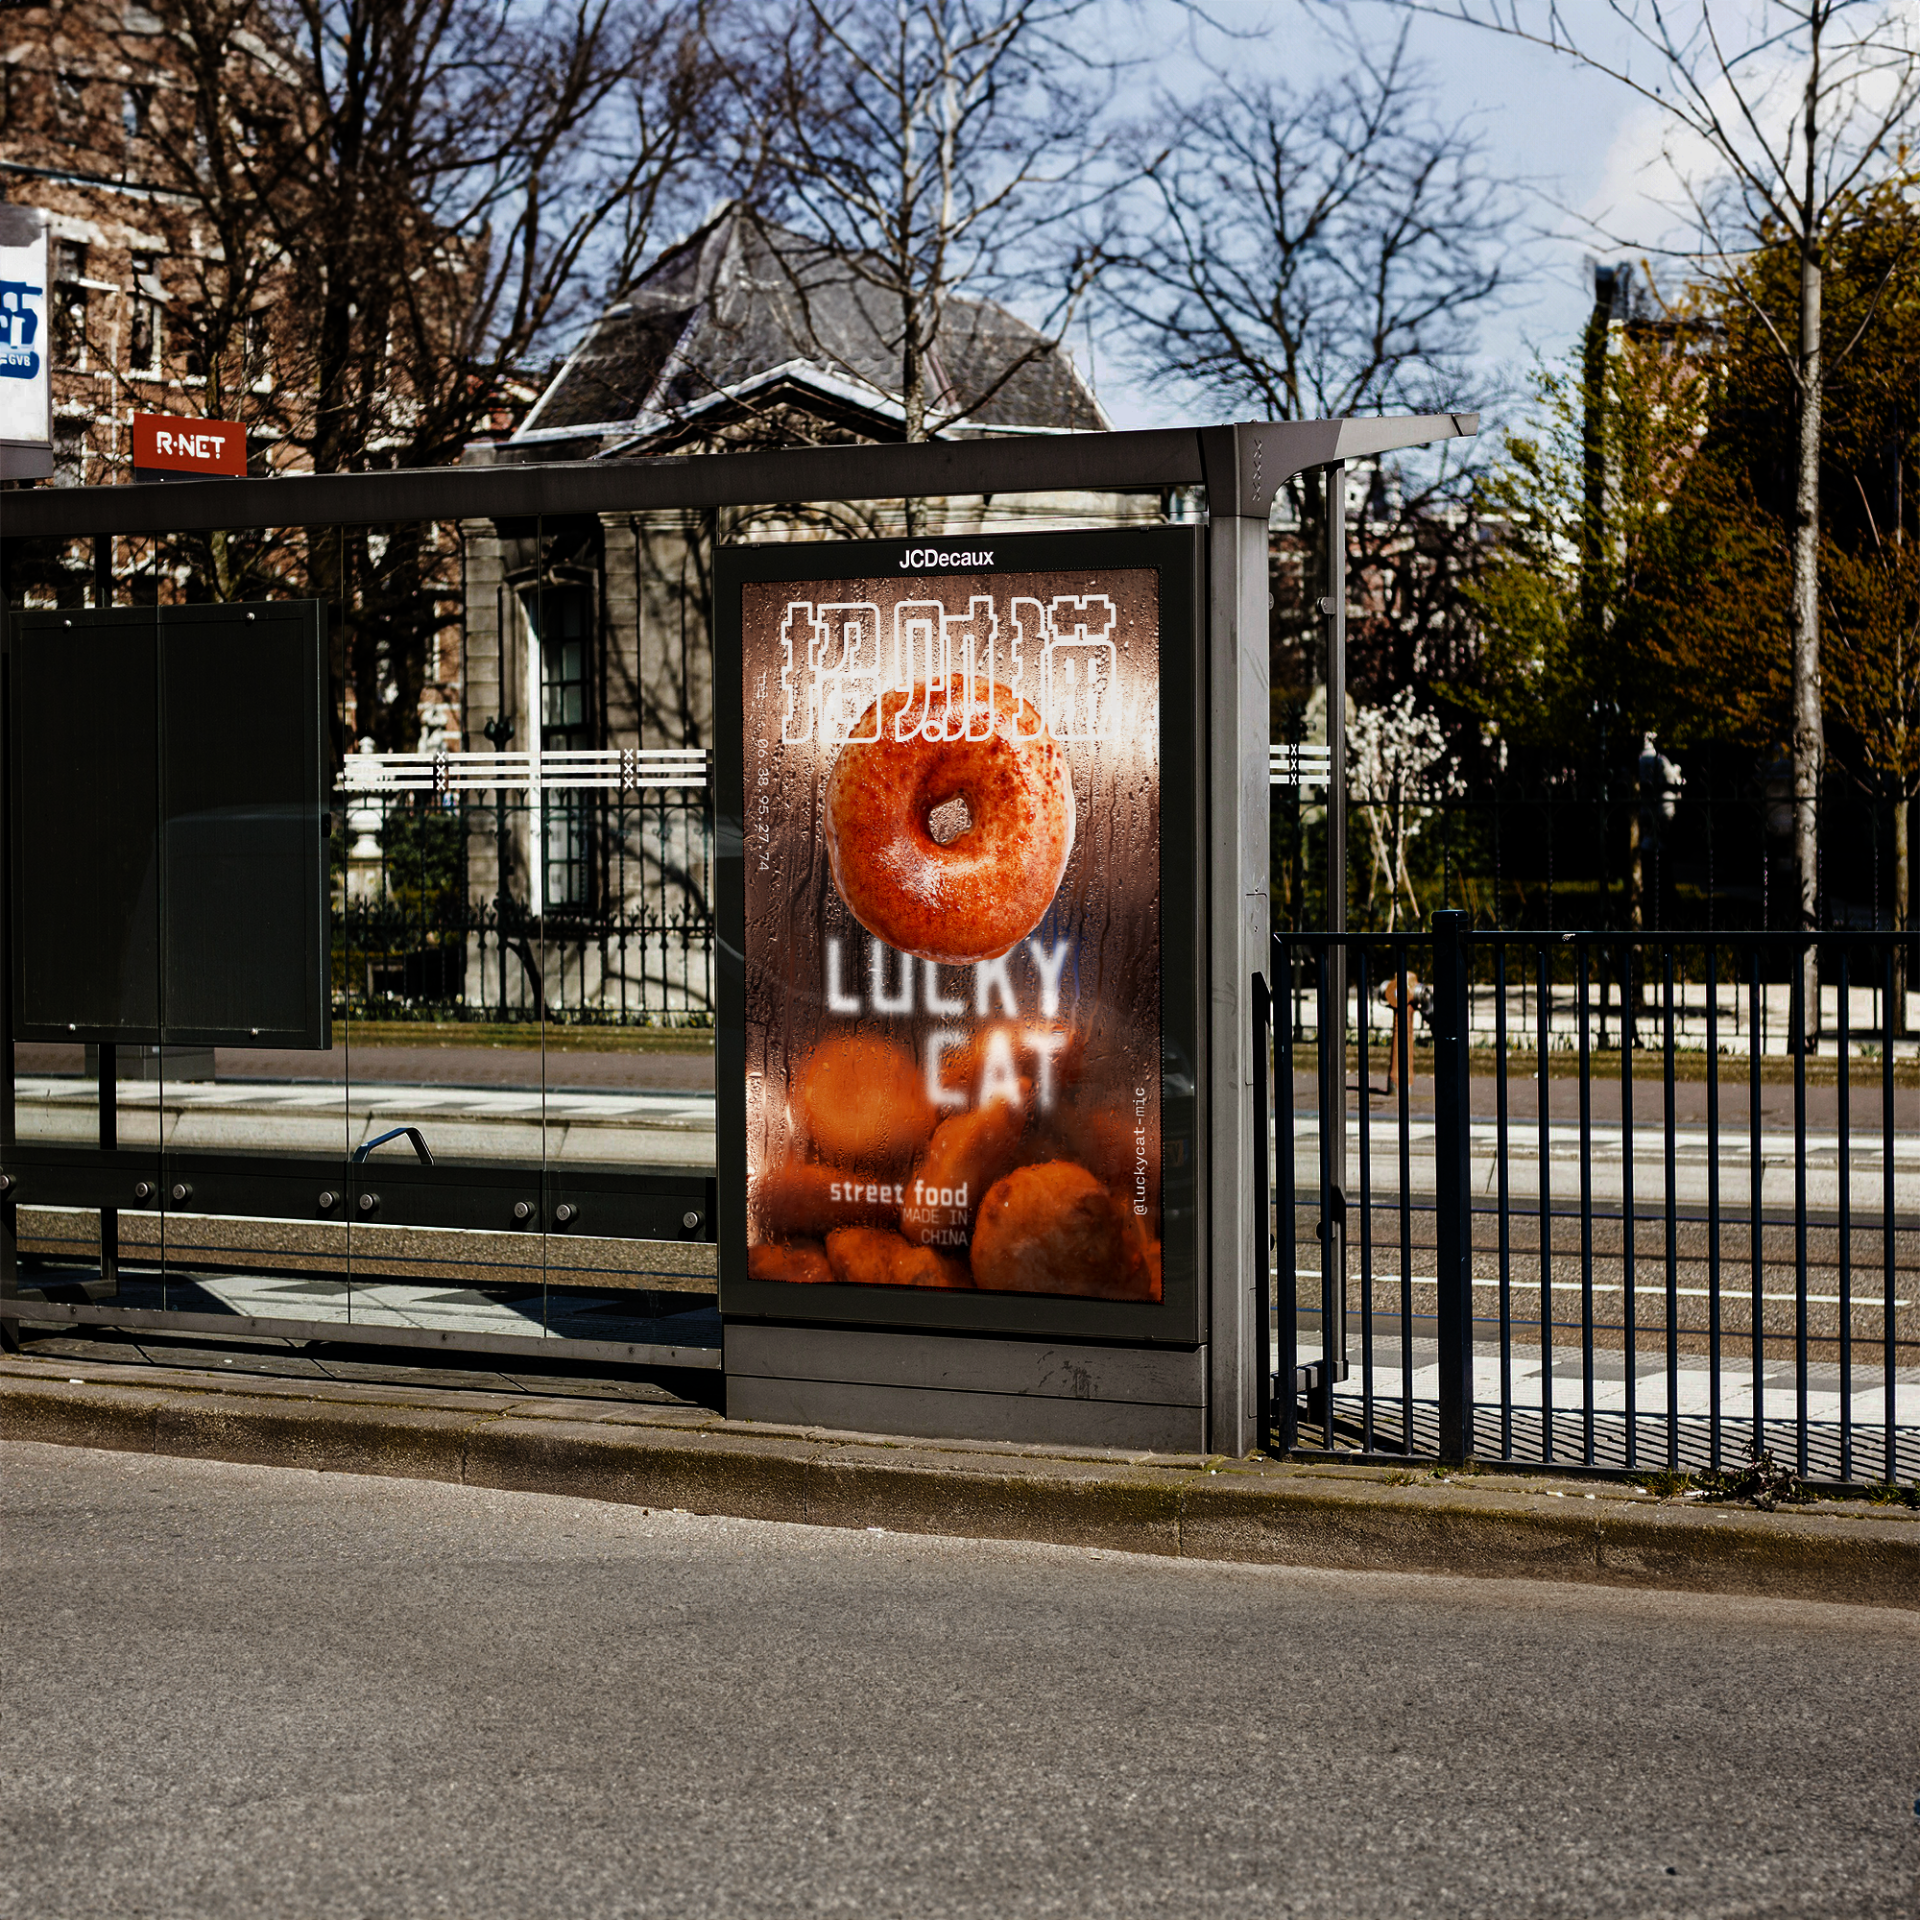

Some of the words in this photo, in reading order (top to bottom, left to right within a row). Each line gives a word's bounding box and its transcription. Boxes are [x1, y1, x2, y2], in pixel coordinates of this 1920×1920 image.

[8, 353, 31, 367] GVB
[899, 549, 994, 569] JCDecaux
[825, 936, 1069, 1019] LUCKY
[924, 1028, 1069, 1110] CAT
[1133, 1087, 1148, 1216] @luckycat-mic
[830, 1181, 904, 1205] street
[914, 1182, 969, 1208] food
[902, 1208, 939, 1224] MADE
[948, 1210, 968, 1226] IN
[920, 1229, 969, 1246] CHINA
